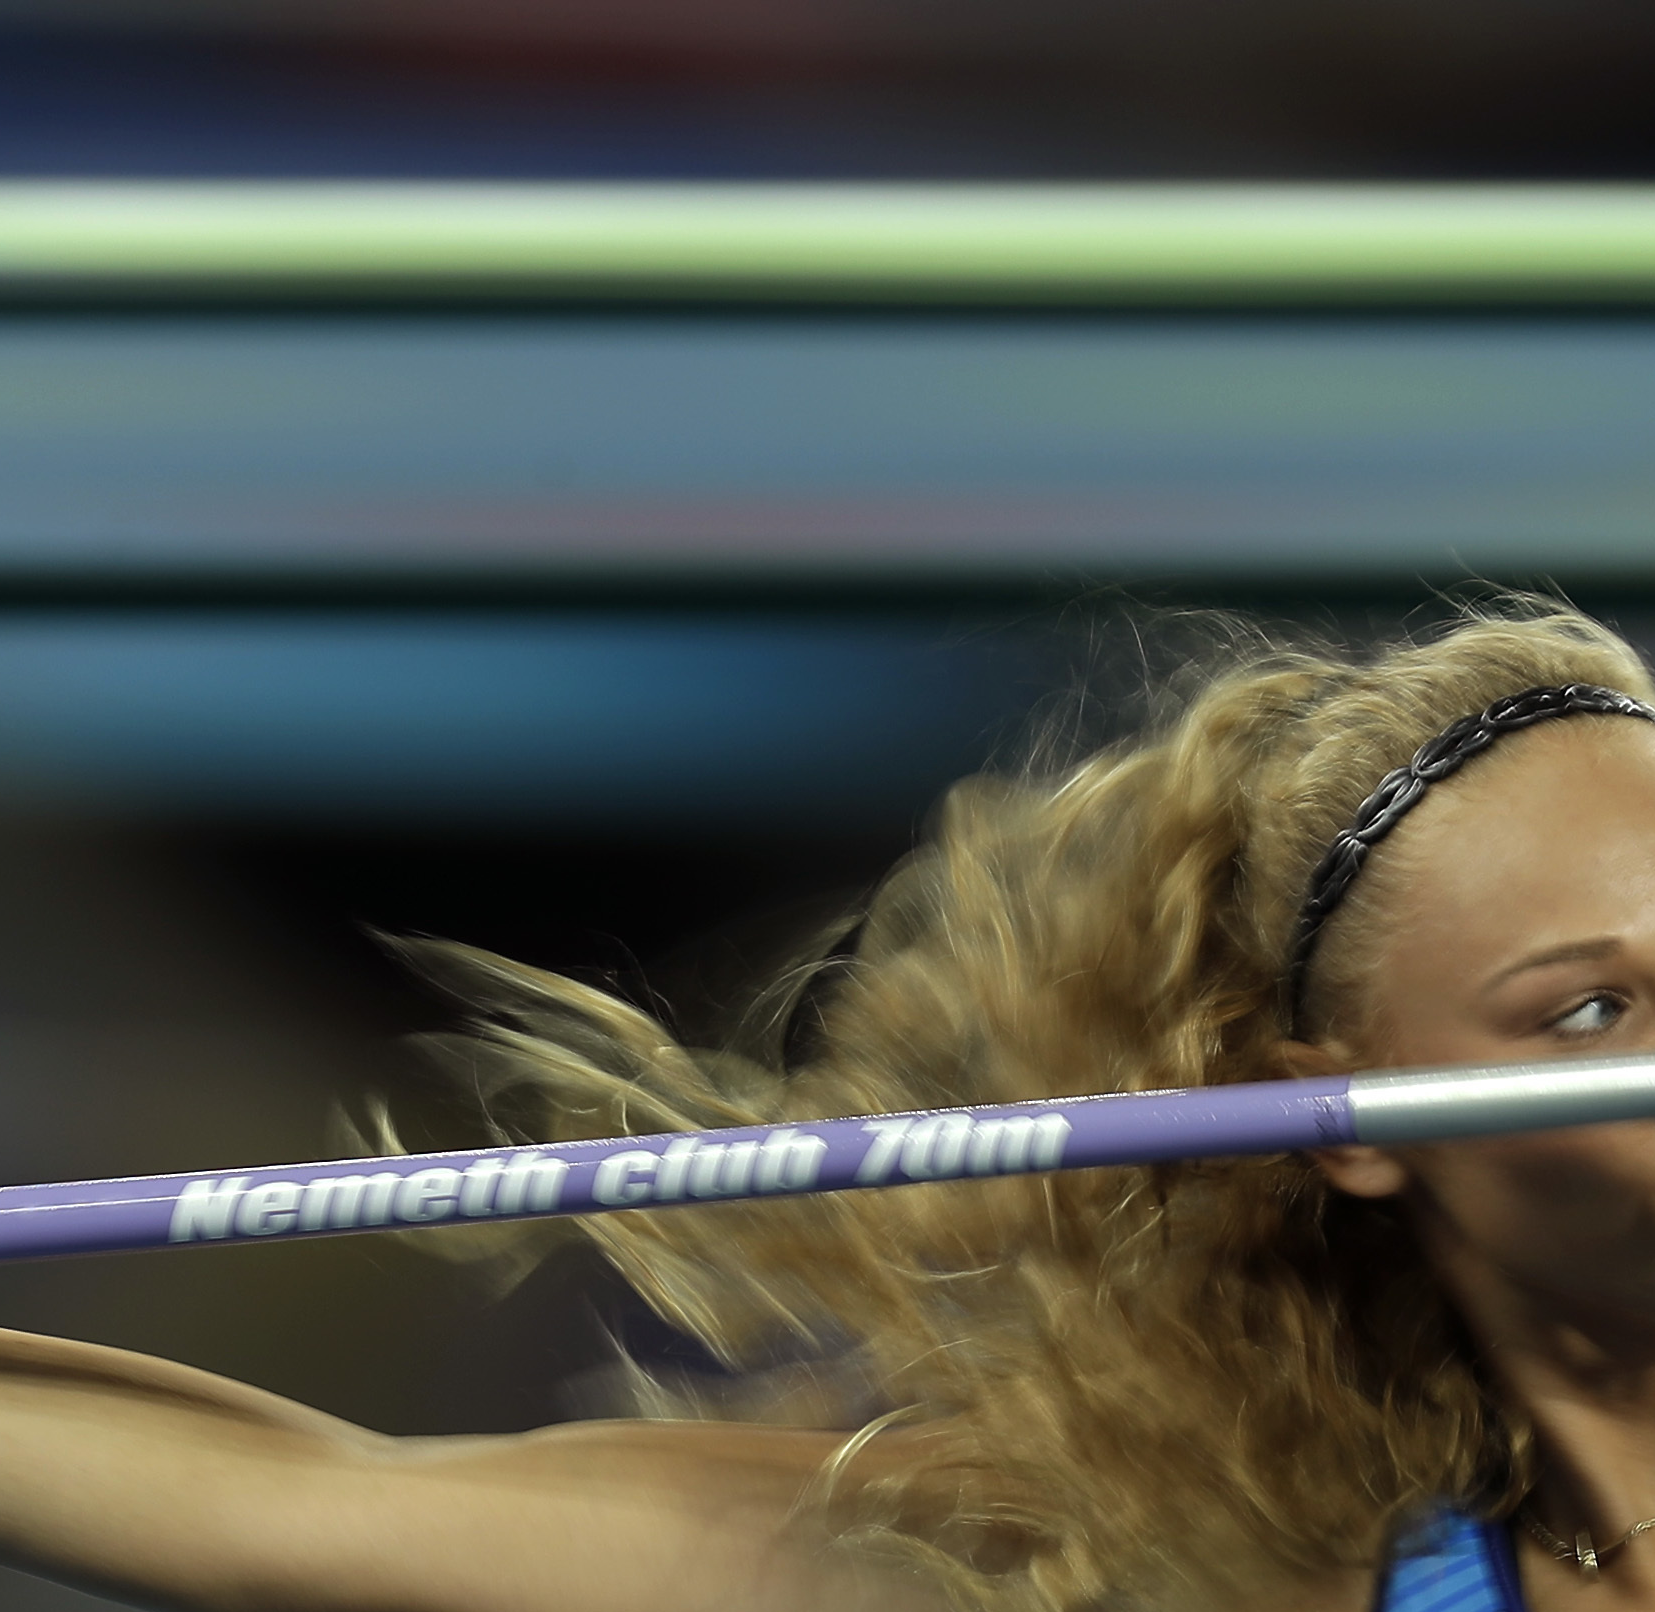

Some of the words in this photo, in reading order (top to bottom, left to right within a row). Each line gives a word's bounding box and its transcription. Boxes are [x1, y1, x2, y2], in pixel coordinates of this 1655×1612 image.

[168, 1153, 568, 1243] Nemeth
[592, 1128, 827, 1206] club
[854, 1112, 1072, 1186] 70m
